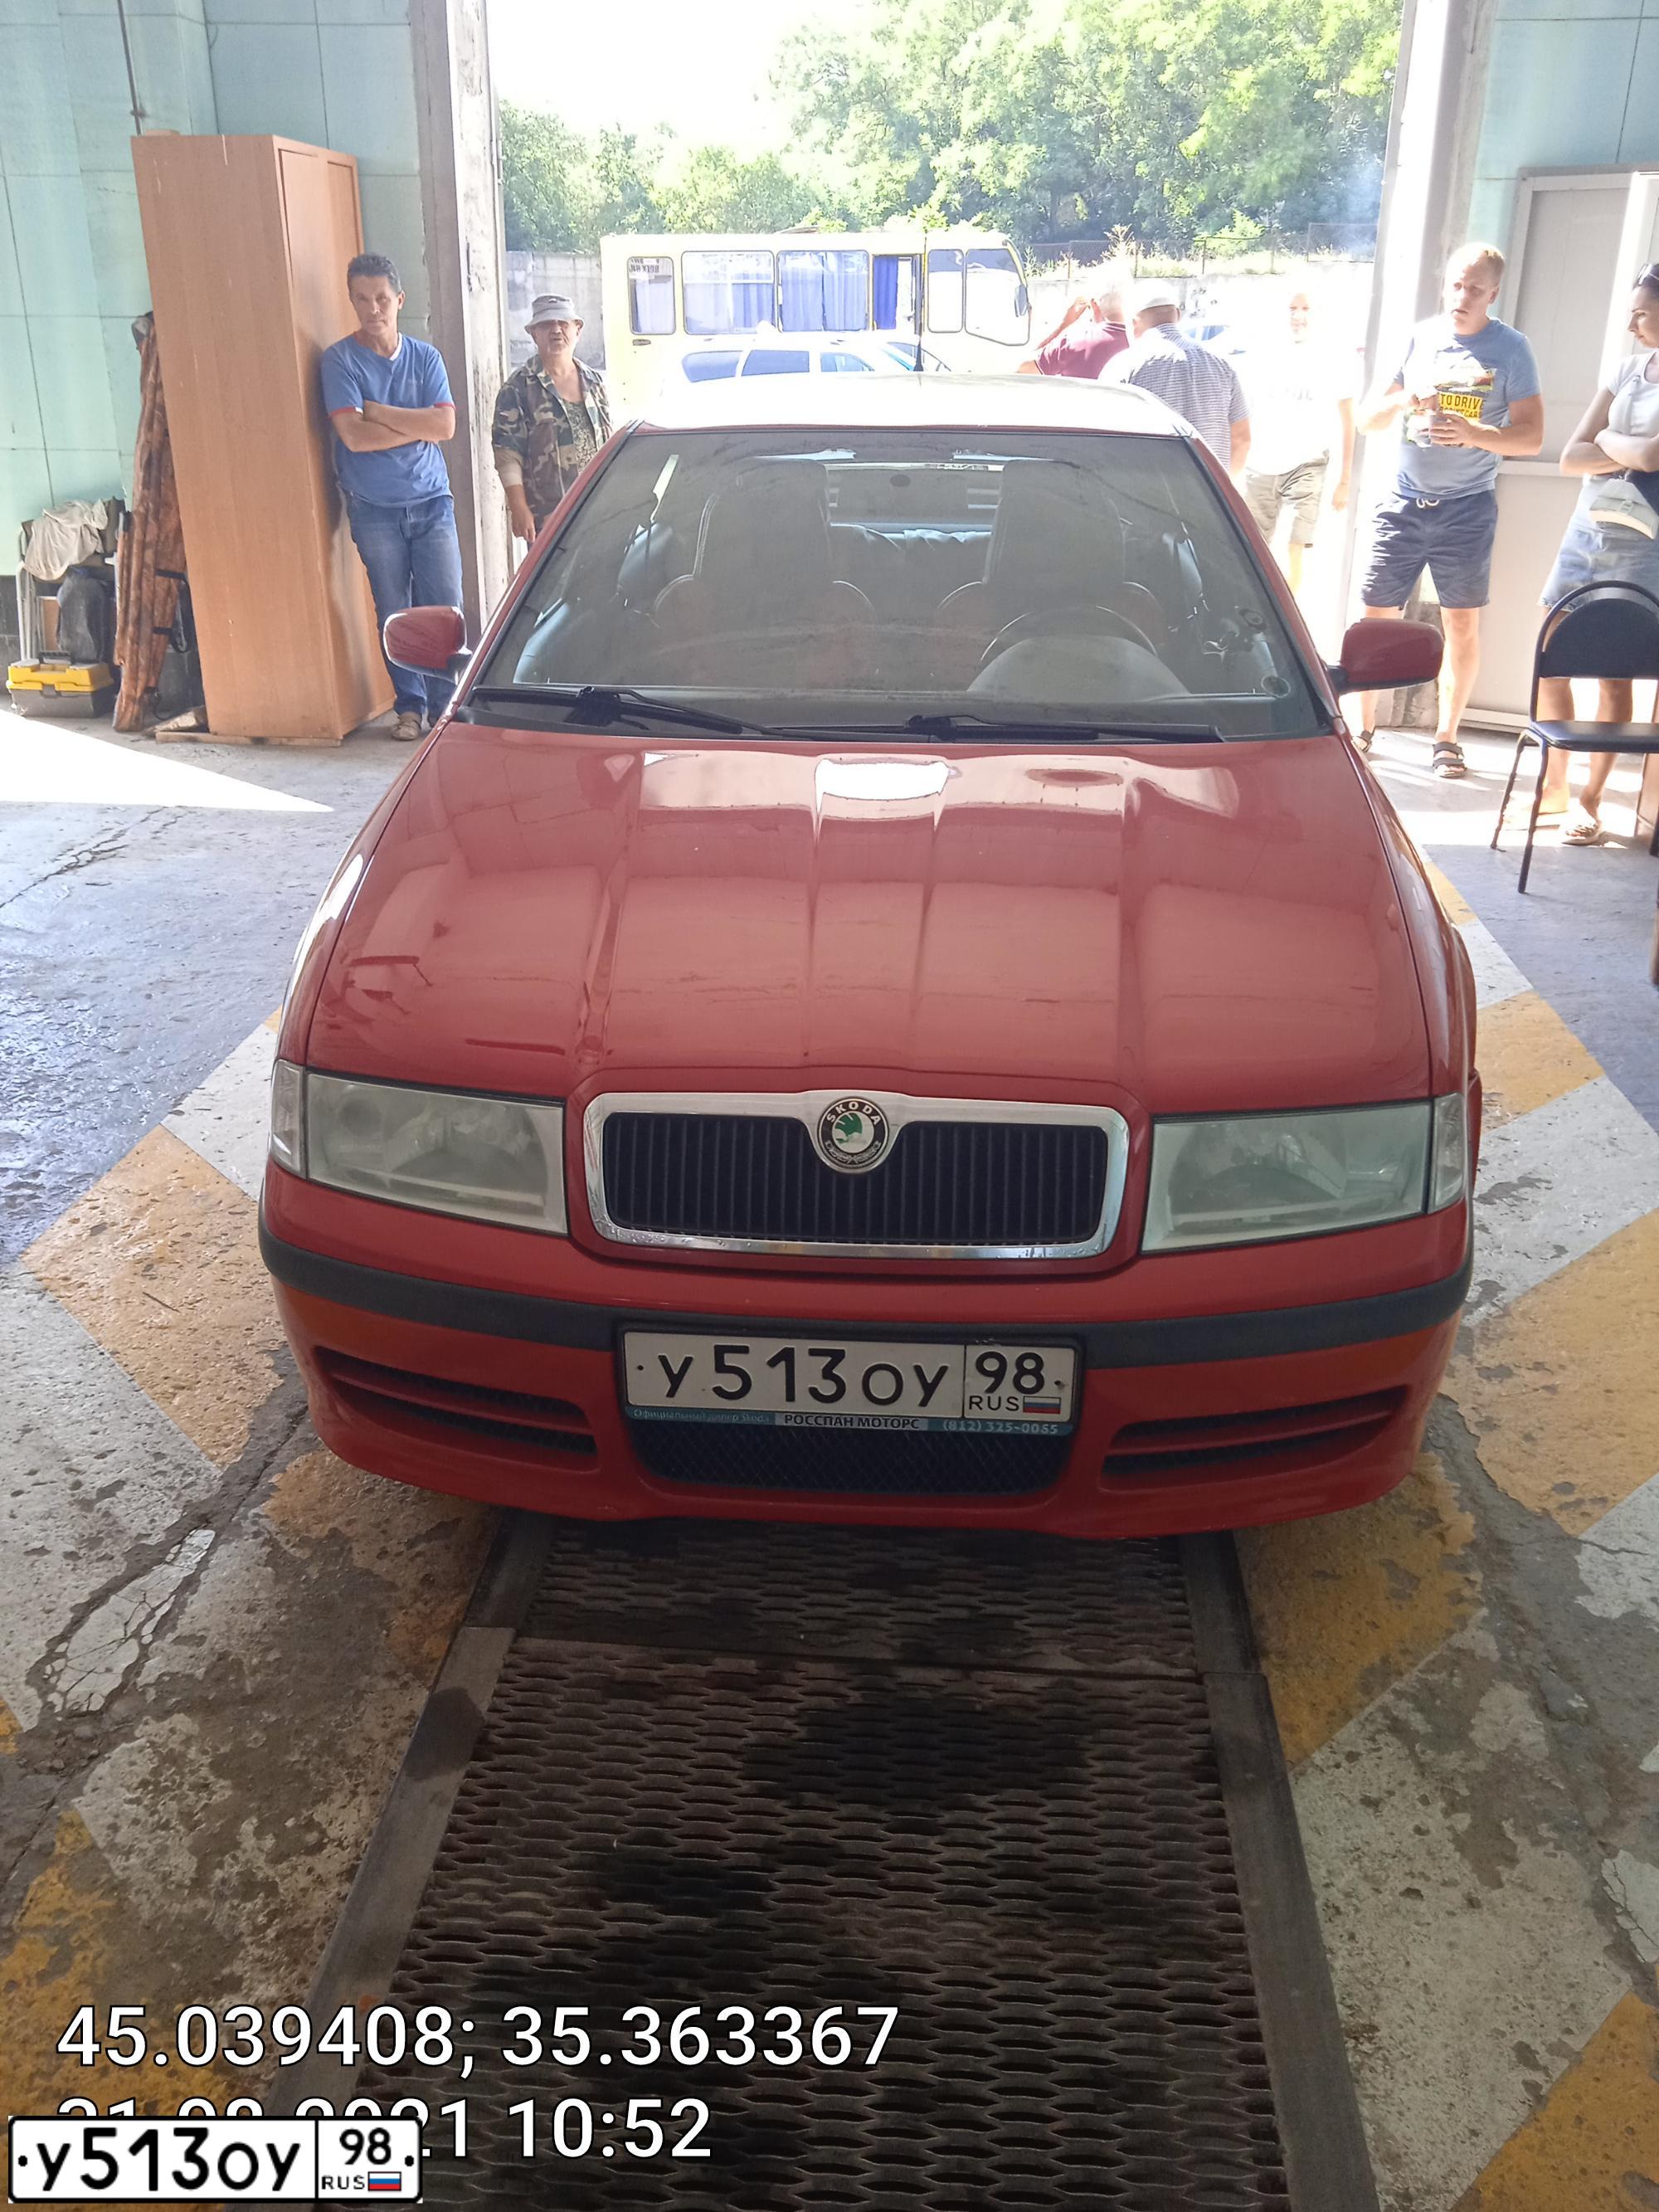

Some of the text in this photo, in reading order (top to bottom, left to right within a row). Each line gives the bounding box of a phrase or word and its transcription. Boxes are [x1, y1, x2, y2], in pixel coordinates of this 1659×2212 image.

[975, 1351, 1046, 1395] 98
[968, 1395, 1020, 1413] RUS
[784, 1414, 921, 1430] РОССПАН МОТОРС
[942, 1420, 982, 1431] (812)
